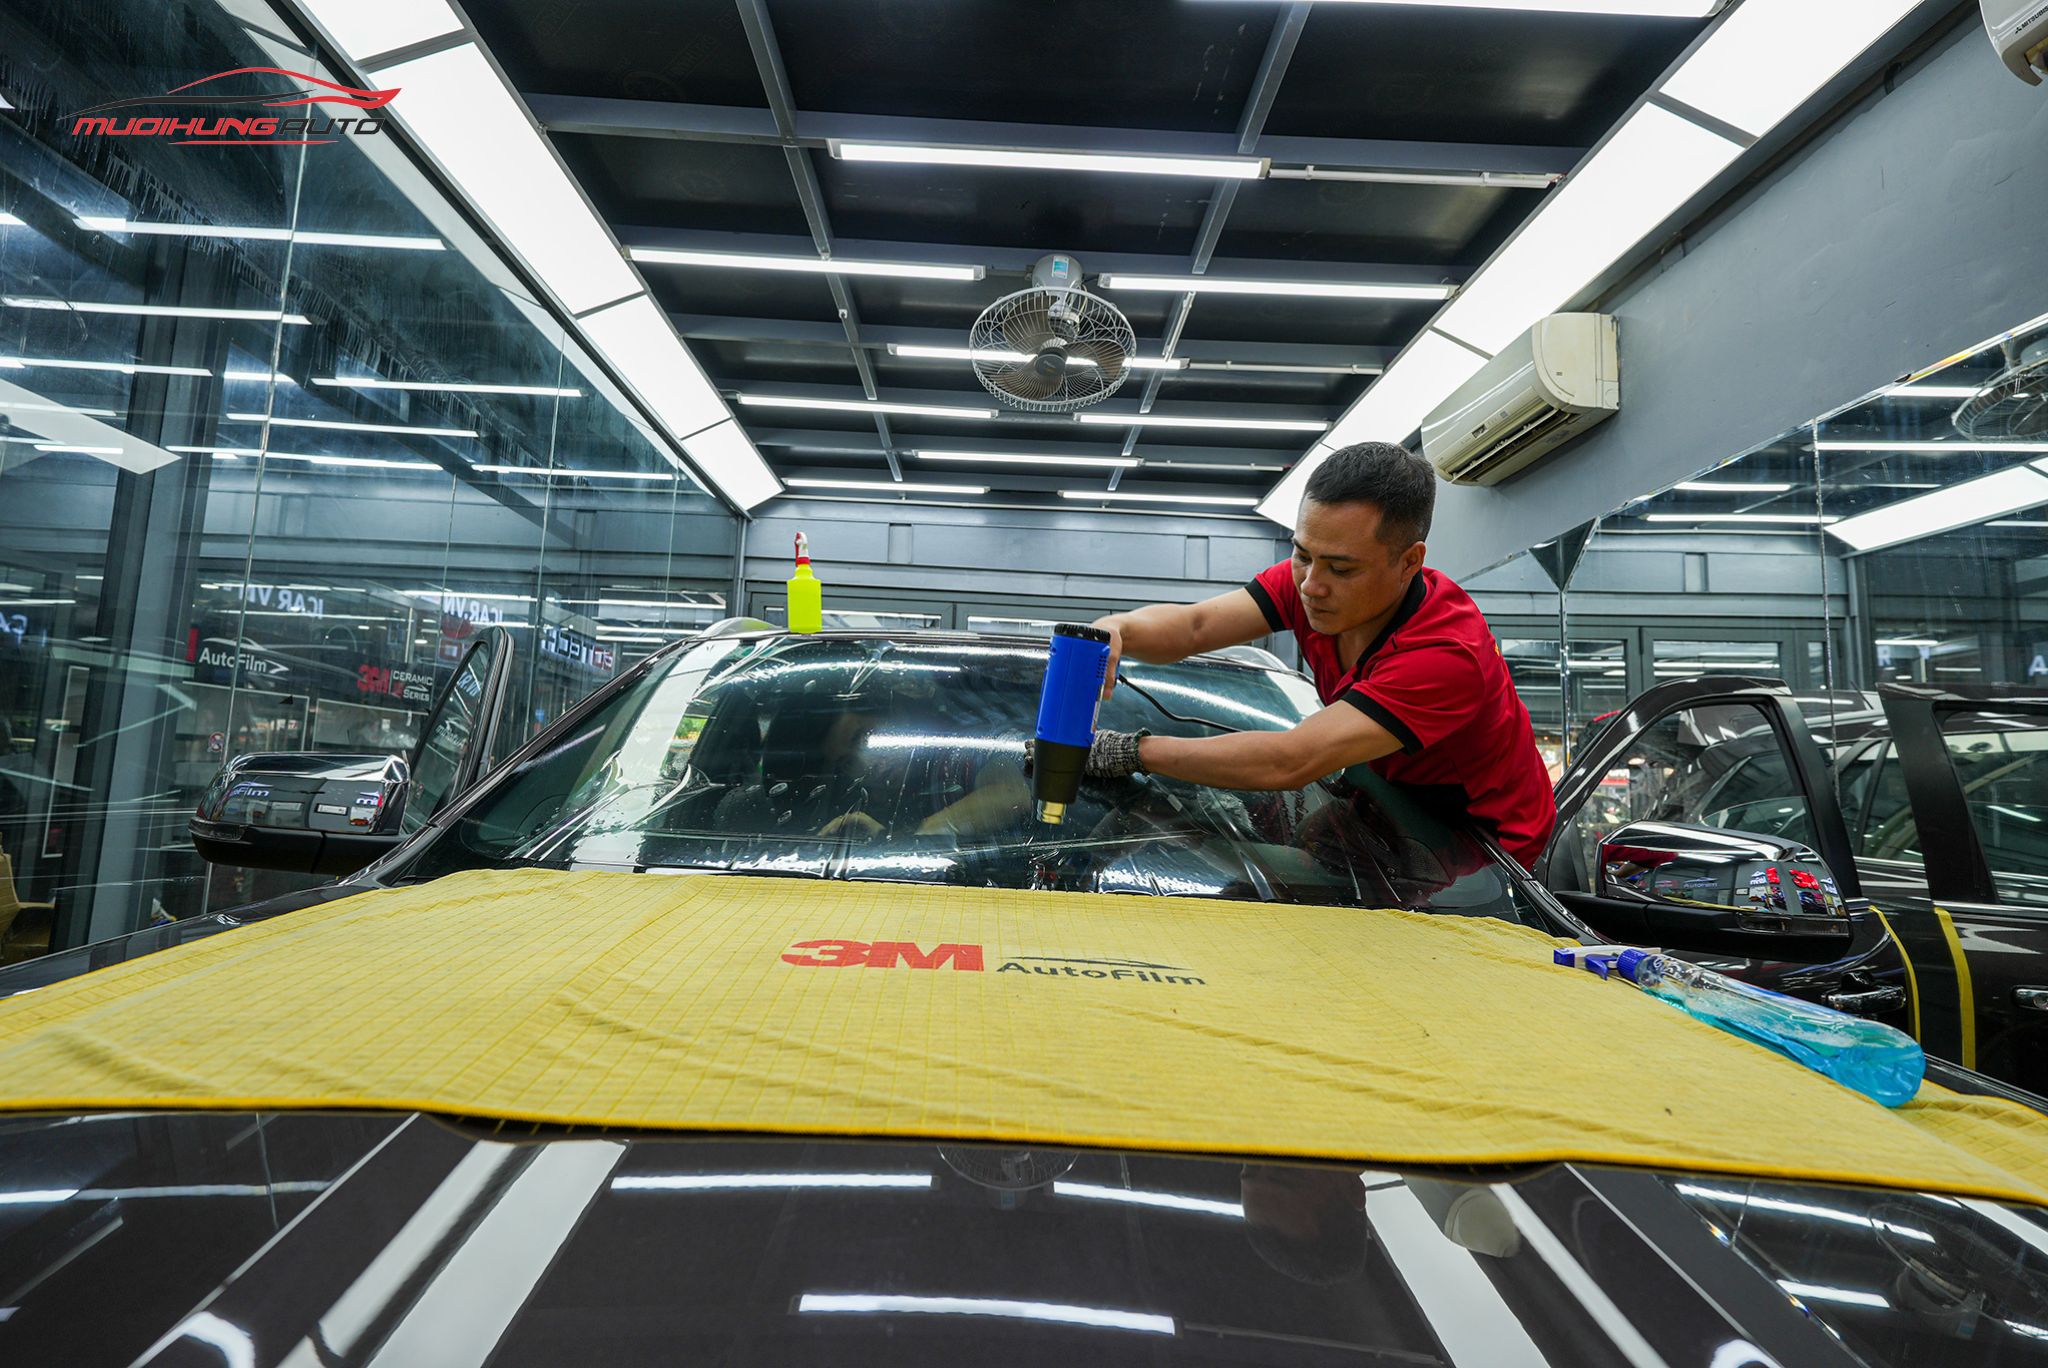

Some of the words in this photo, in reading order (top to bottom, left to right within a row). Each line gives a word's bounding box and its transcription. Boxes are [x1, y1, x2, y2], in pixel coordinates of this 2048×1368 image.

[392, 670, 434, 686] CERAMIC
[780, 939, 985, 972] 3M
[996, 961, 1206, 986] AutoFilm
